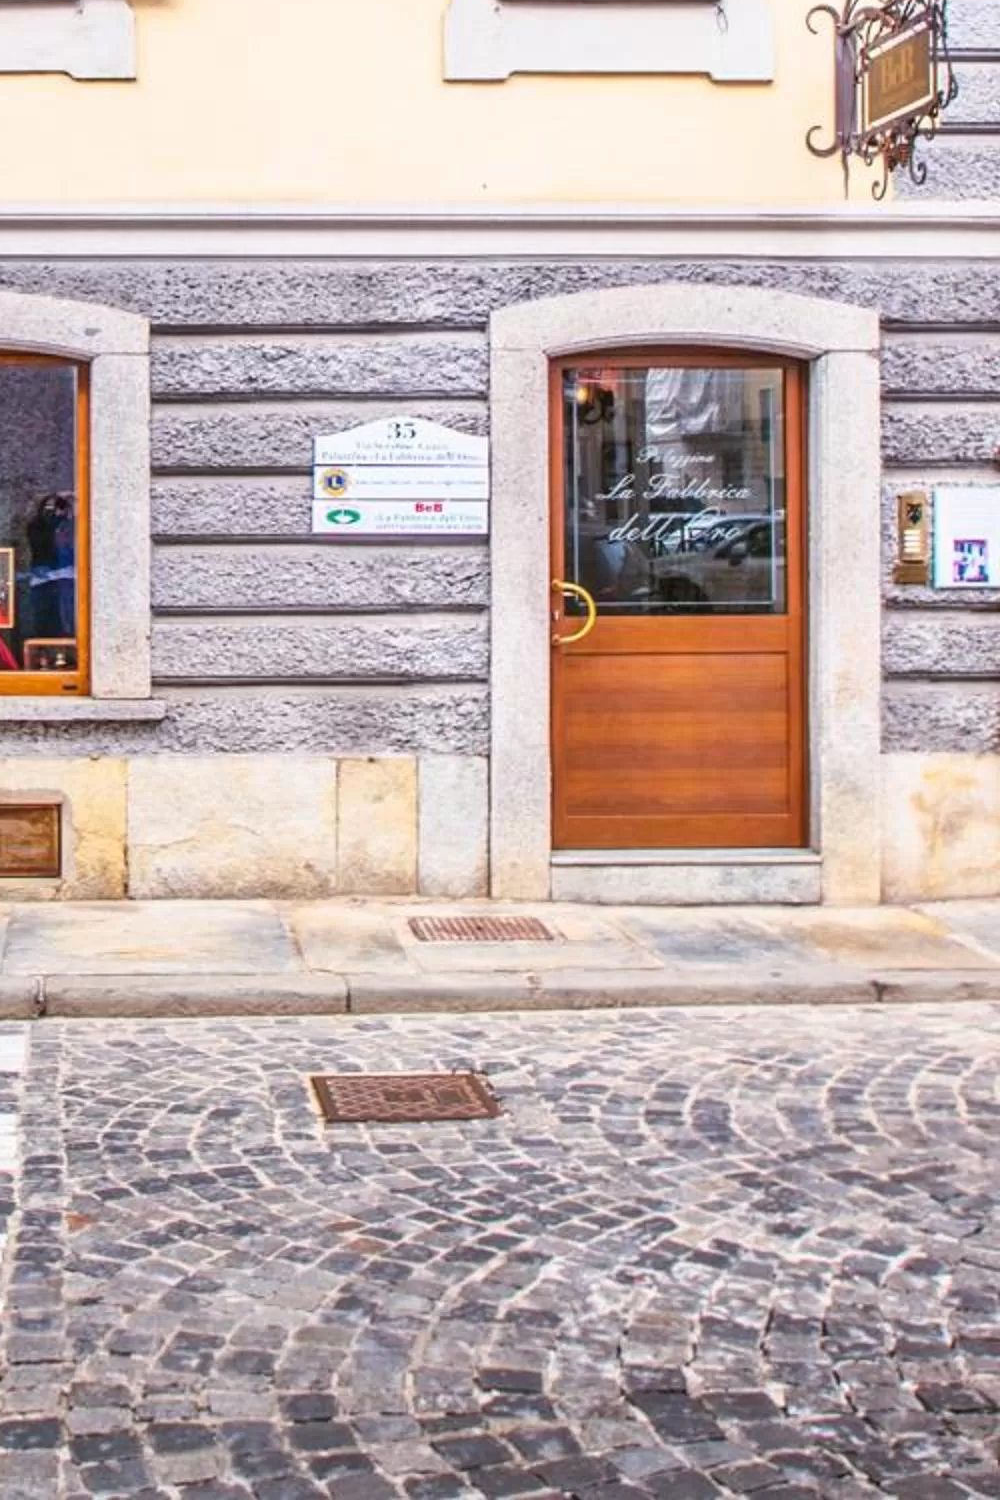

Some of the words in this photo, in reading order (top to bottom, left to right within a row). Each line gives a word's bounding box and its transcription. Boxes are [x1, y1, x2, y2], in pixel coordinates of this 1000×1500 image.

[387, 423, 416, 438] 35
[595, 474, 635, 500] La
[643, 473, 752, 500] Fabbrica
